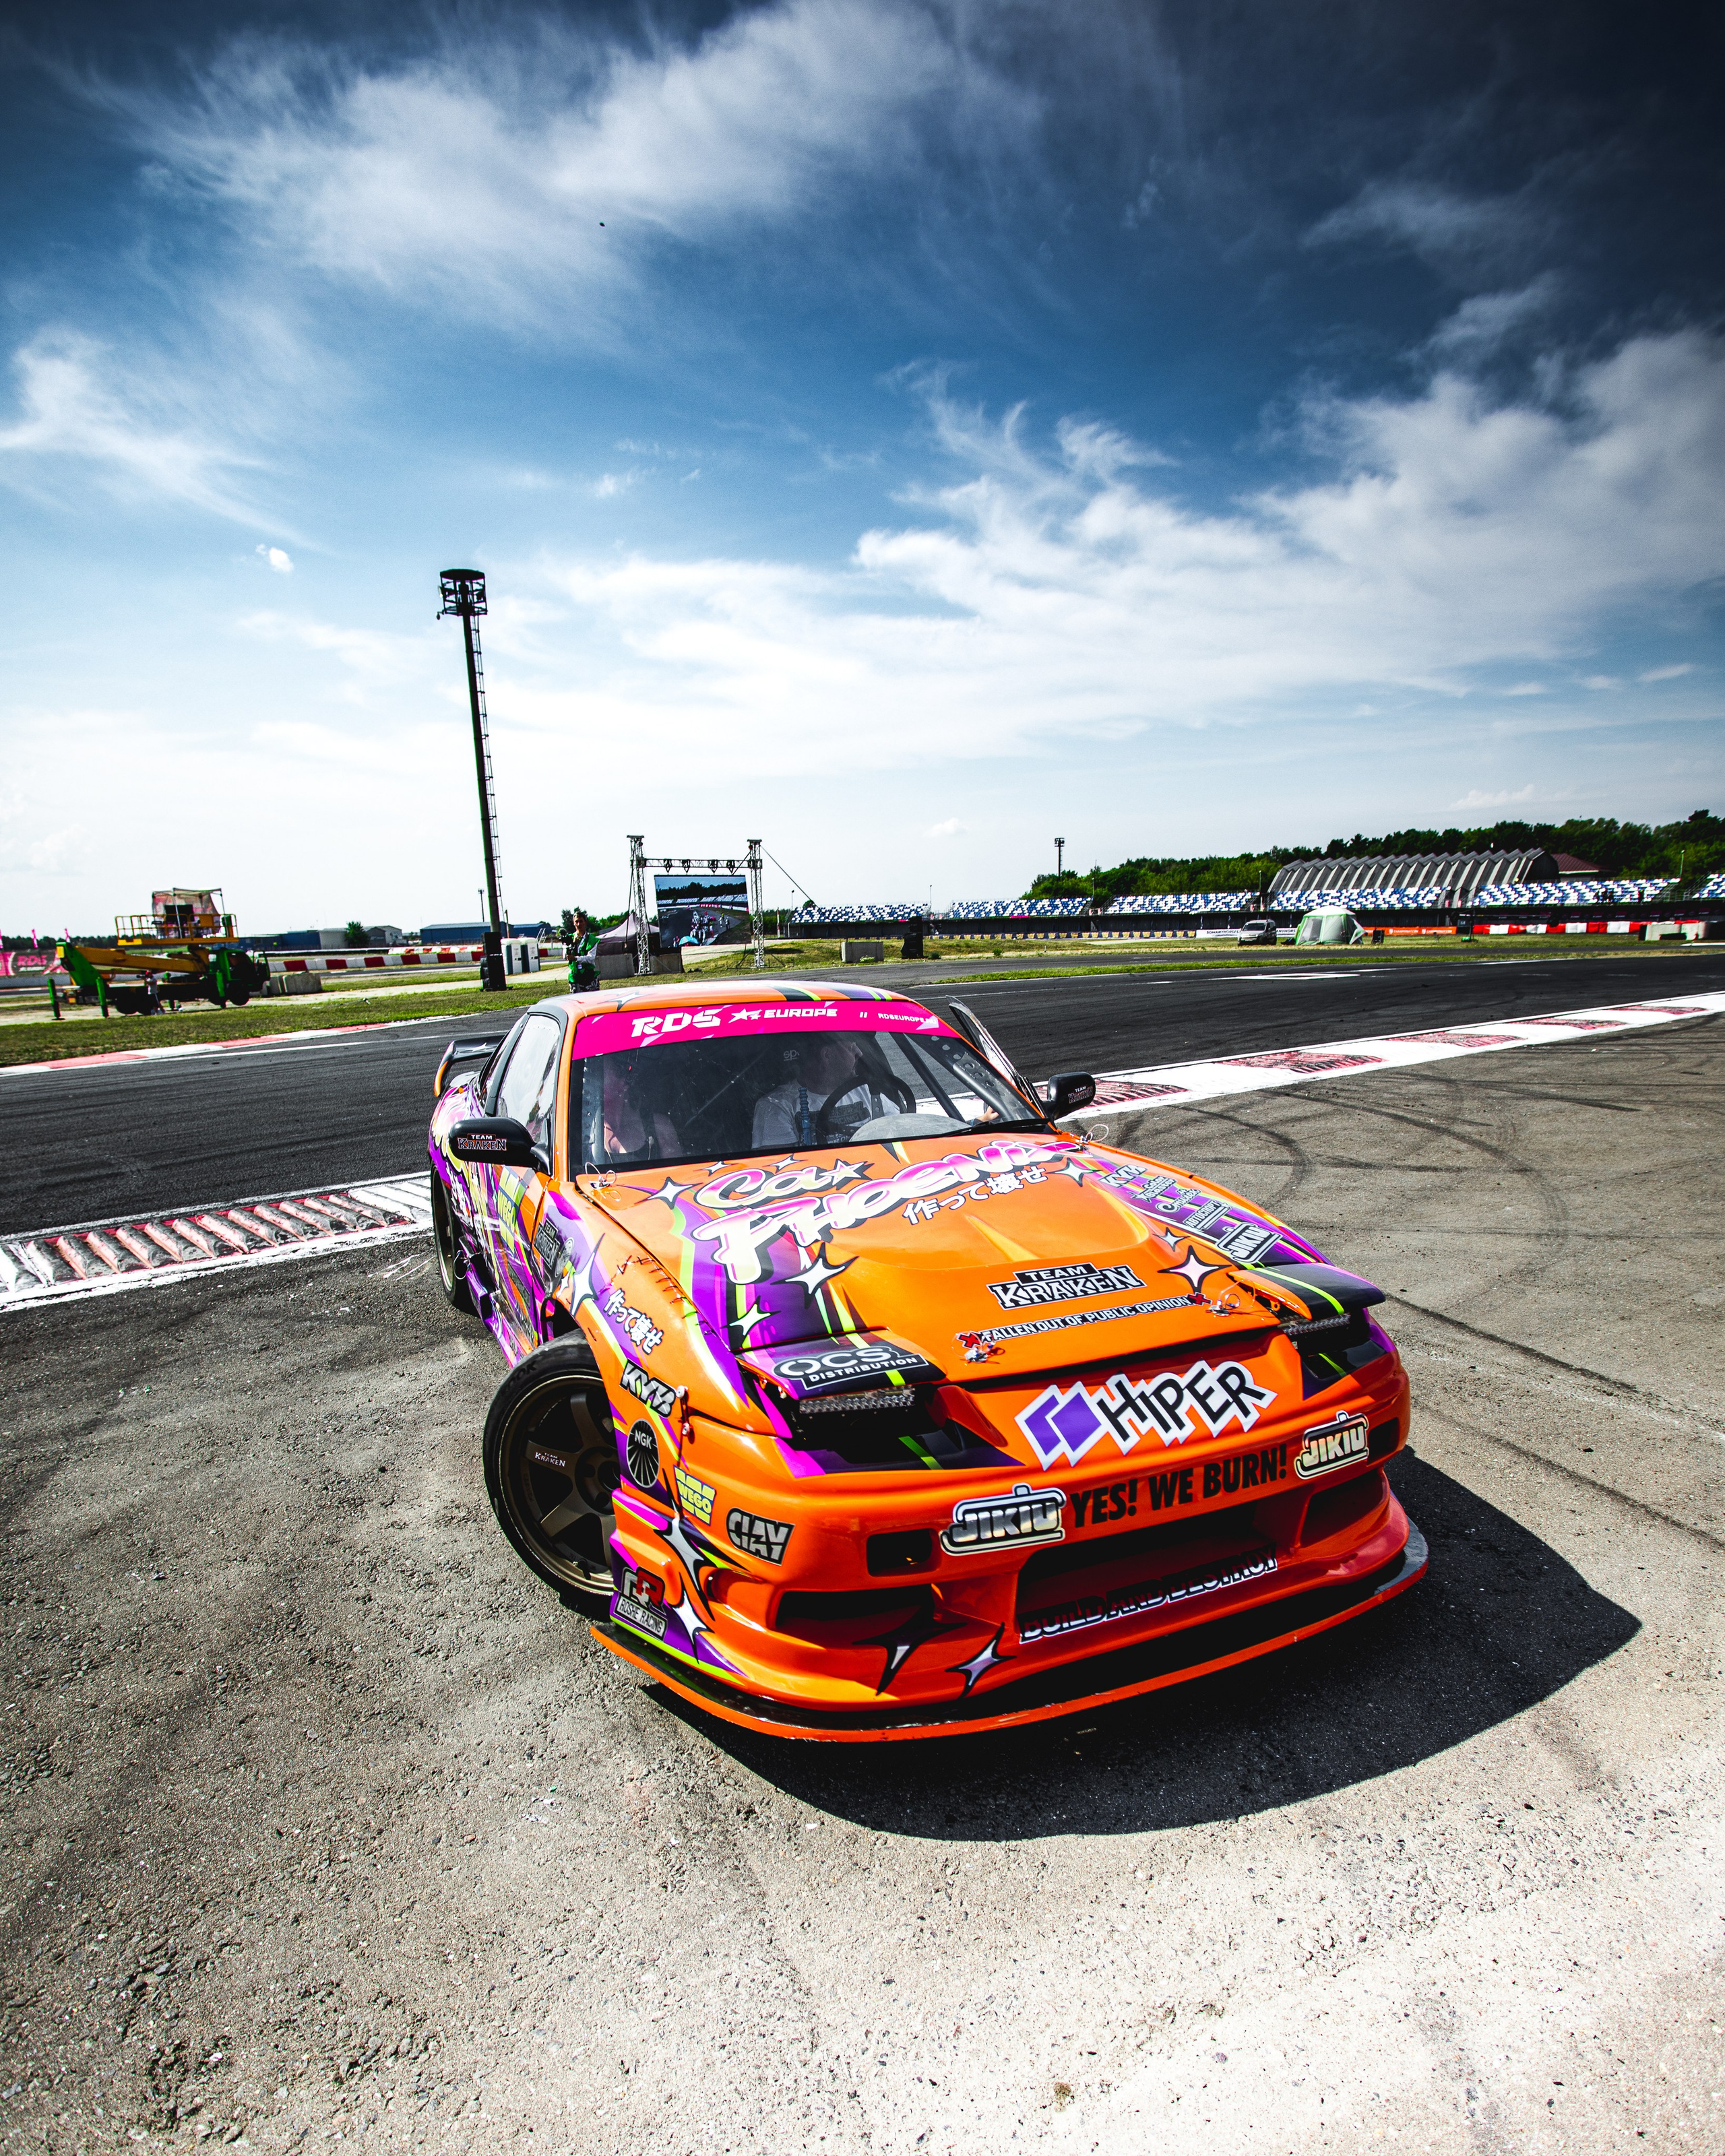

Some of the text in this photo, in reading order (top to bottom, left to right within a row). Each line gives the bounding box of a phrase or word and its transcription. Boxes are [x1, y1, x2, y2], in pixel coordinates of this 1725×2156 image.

[631, 1008, 838, 1038] RDS EUROPE
[458, 1137, 507, 1151] KRAKEN
[902, 1166, 1048, 1226] 作って壊せ
[1146, 1178, 1177, 1199] Blaster
[1185, 1200, 1220, 1227] АВТОСПОРТ
[543, 1222, 556, 1239] TEAM
[1227, 1226, 1272, 1259] JIKIU
[992, 1265, 1146, 1308] KRAKEN
[1025, 1265, 1088, 1281] TEAM
[604, 1288, 664, 1354] 作って壊せ
[982, 1296, 1194, 1342] FALLEN OUT OF PUBLIC OPINION
[780, 1347, 891, 1376] OCS
[809, 1357, 918, 1383] DISTRIBUTION
[621, 1358, 676, 1417] KYB
[635, 1430, 652, 1450] NGK
[1302, 1425, 1366, 1467] JIKIU
[534, 1451, 566, 1467] KRAKEN
[676, 1480, 712, 1514] WEGO
[1069, 1443, 1287, 1528] YES! WE BURN!
[952, 1502, 1058, 1543] JIKIU
[1023, 1548, 1278, 1639] BUILD AND DESTROY
[619, 1598, 663, 1633] ROSHE RACING
